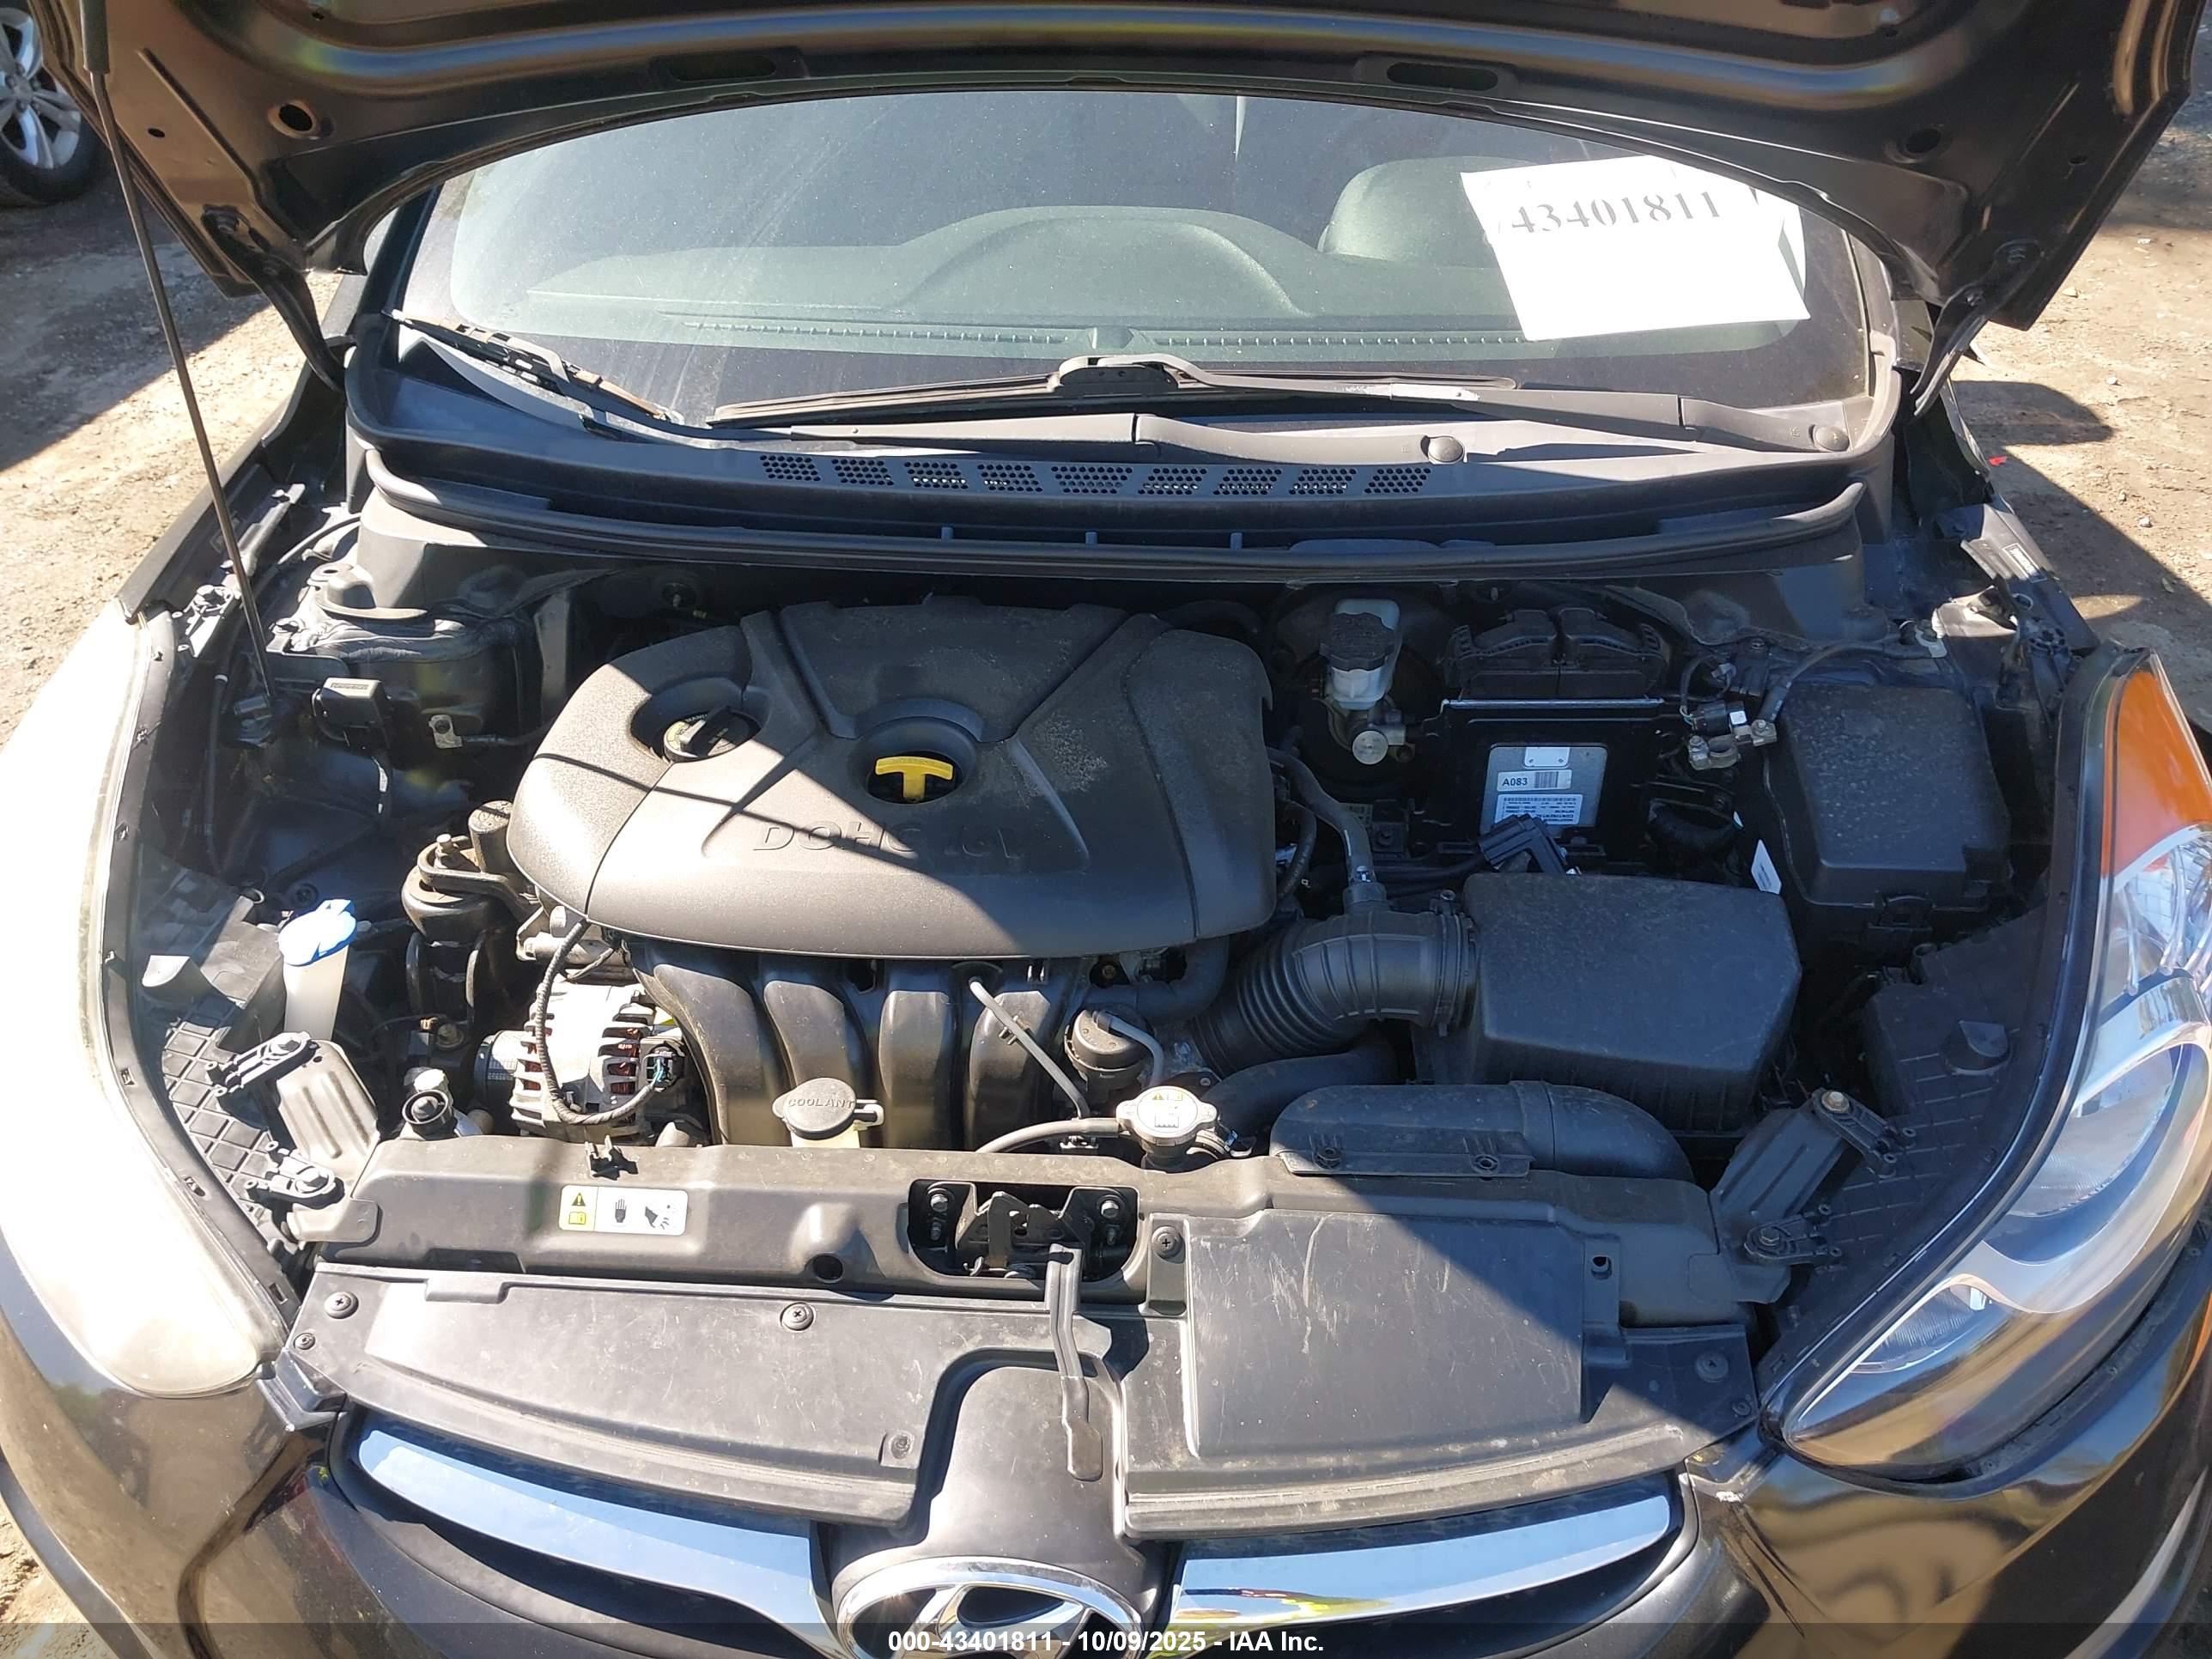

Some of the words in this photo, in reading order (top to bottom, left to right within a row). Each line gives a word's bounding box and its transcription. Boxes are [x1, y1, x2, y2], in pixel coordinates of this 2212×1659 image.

[1512, 191, 1720, 233] 43401811
[1502, 777, 1528, 787] A083
[752, 819, 922, 852] DOHC
[787, 1098, 855, 1109] COOLANT
